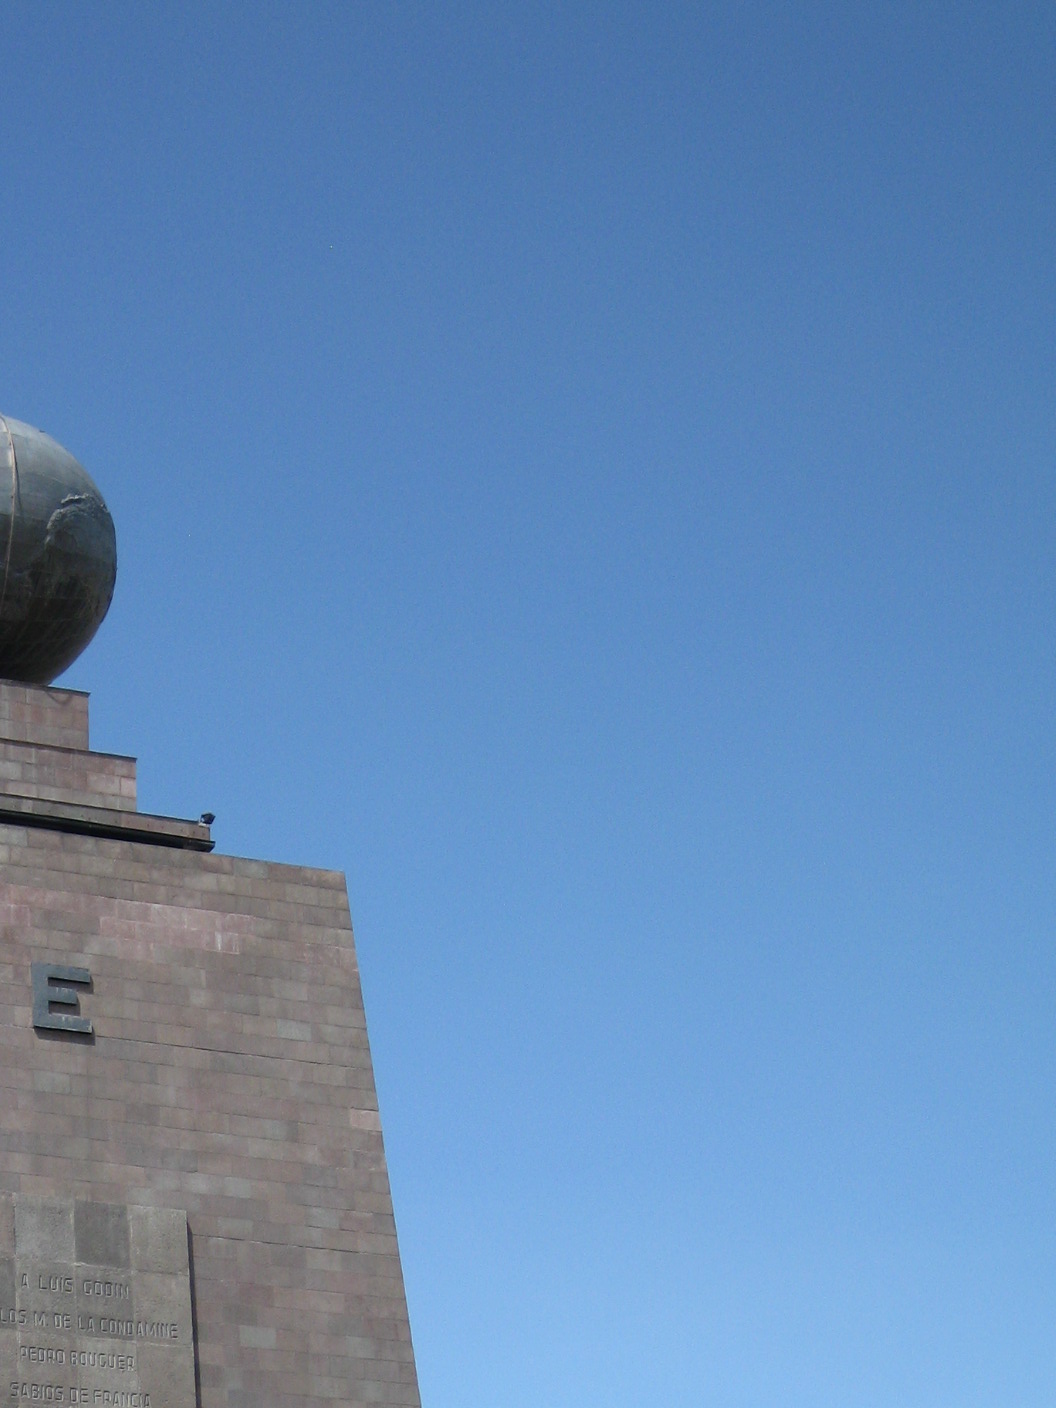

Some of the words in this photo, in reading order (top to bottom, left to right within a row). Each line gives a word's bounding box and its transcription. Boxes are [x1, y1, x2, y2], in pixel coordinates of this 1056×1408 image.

[31, 961, 93, 1034] E
[21, 1273, 28, 1289] A
[38, 1275, 74, 1293] LUIS
[83, 1278, 130, 1299] GODIN
[54, 1313, 71, 1329] DE
[77, 1316, 96, 1333] LA
[100, 1318, 179, 1339] CONDAMINE
[20, 1345, 65, 1365] PEDRO
[10, 1382, 64, 1402] SABIOS
[69, 1387, 89, 1403] DE
